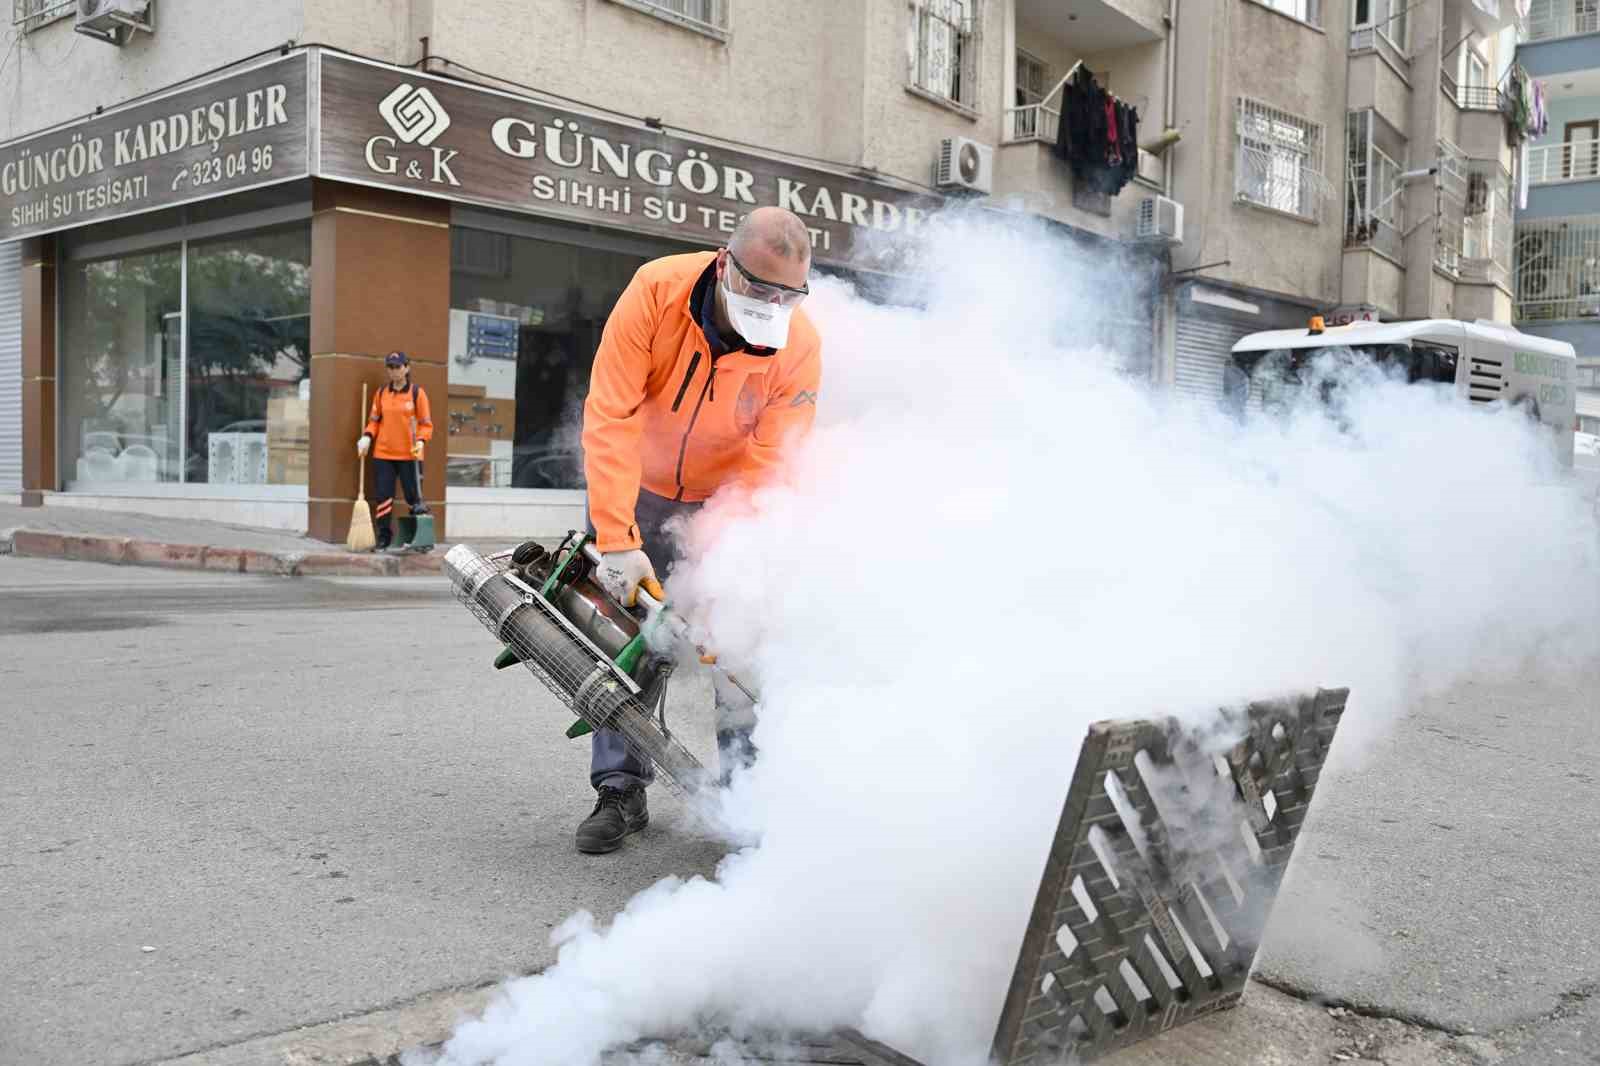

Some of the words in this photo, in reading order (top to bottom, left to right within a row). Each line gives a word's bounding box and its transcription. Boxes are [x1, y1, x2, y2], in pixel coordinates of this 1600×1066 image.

[2, 132, 104, 196] GÜNGÖR
[114, 83, 288, 167] KARDEŞLER
[192, 156, 223, 187] 323
[226, 152, 247, 179] 04
[251, 144, 273, 173] 96
[365, 135, 400, 175] G
[405, 159, 424, 180] &
[430, 146, 461, 187] K
[11, 198, 50, 227] SIHHİ
[53, 194, 73, 218] SU
[77, 174, 149, 213] TESİSATI
[491, 116, 756, 204] GÜNGÖR
[776, 176, 926, 236] KARDE
[532, 174, 631, 214] SIHHİ
[643, 196, 688, 224] SU
